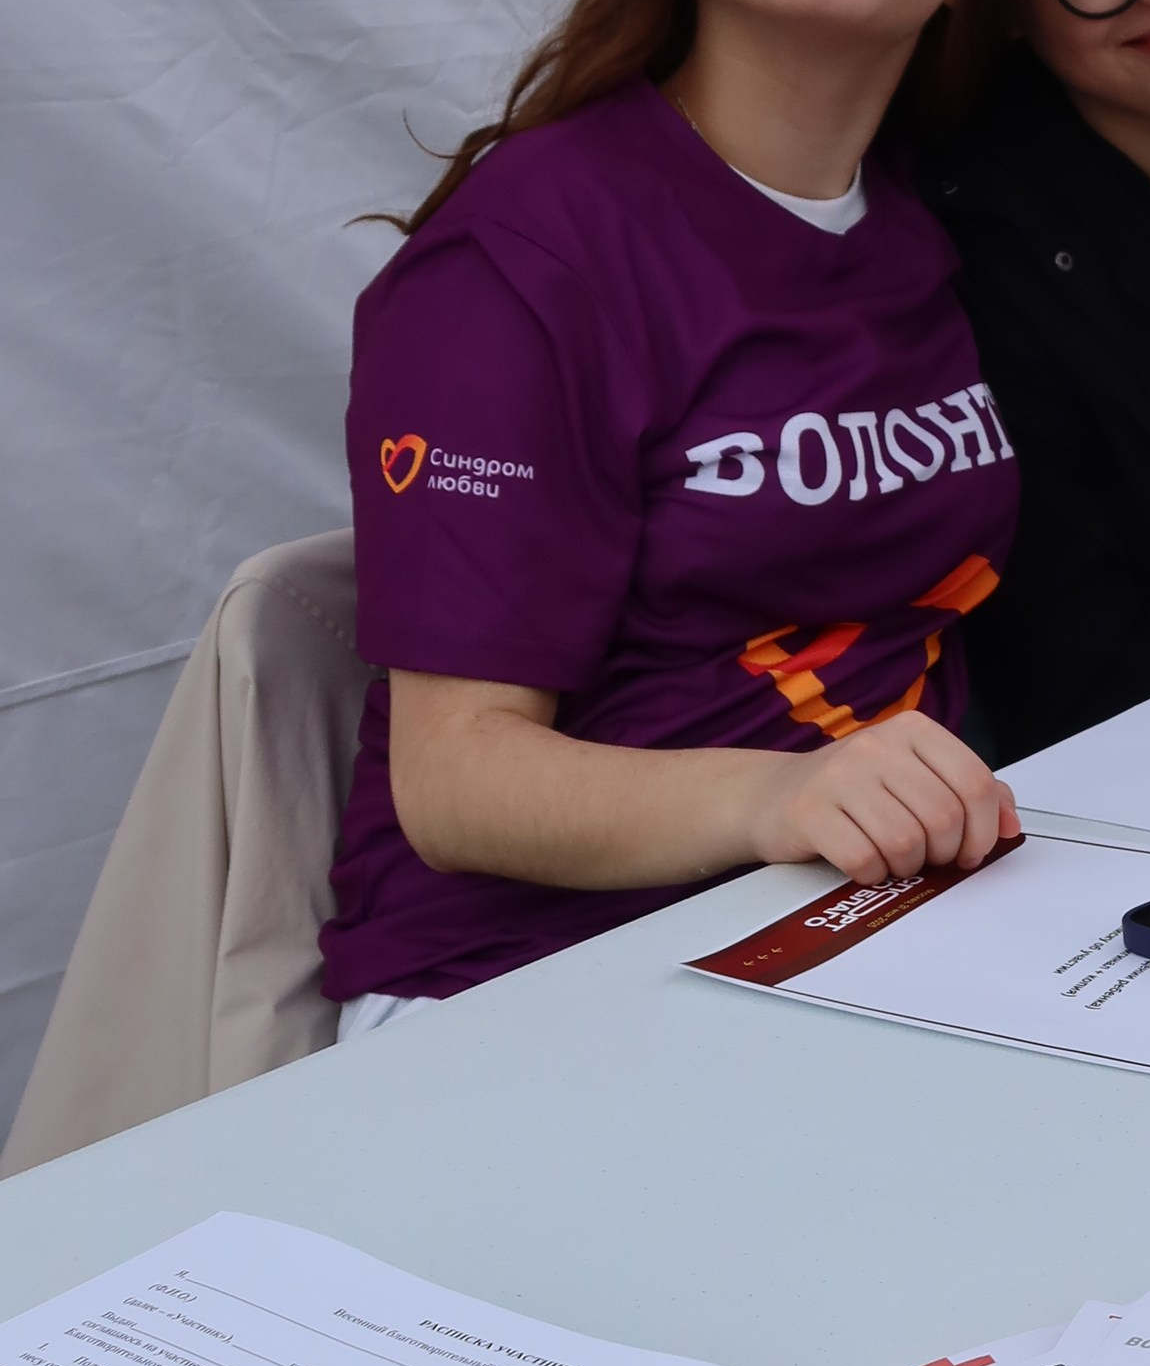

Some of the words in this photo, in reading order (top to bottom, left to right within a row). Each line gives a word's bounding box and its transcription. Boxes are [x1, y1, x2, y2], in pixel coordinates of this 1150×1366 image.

[429, 447, 535, 481] Синдром
[427, 473, 500, 499] любви
[122, 1296, 159, 1312] (далее
[332, 1308, 389, 1333] Весенний
[81, 1320, 142, 1346] соглашаюсь
[141, 1343, 158, 1352] на
[419, 1317, 496, 1357] РАСПИСКА
